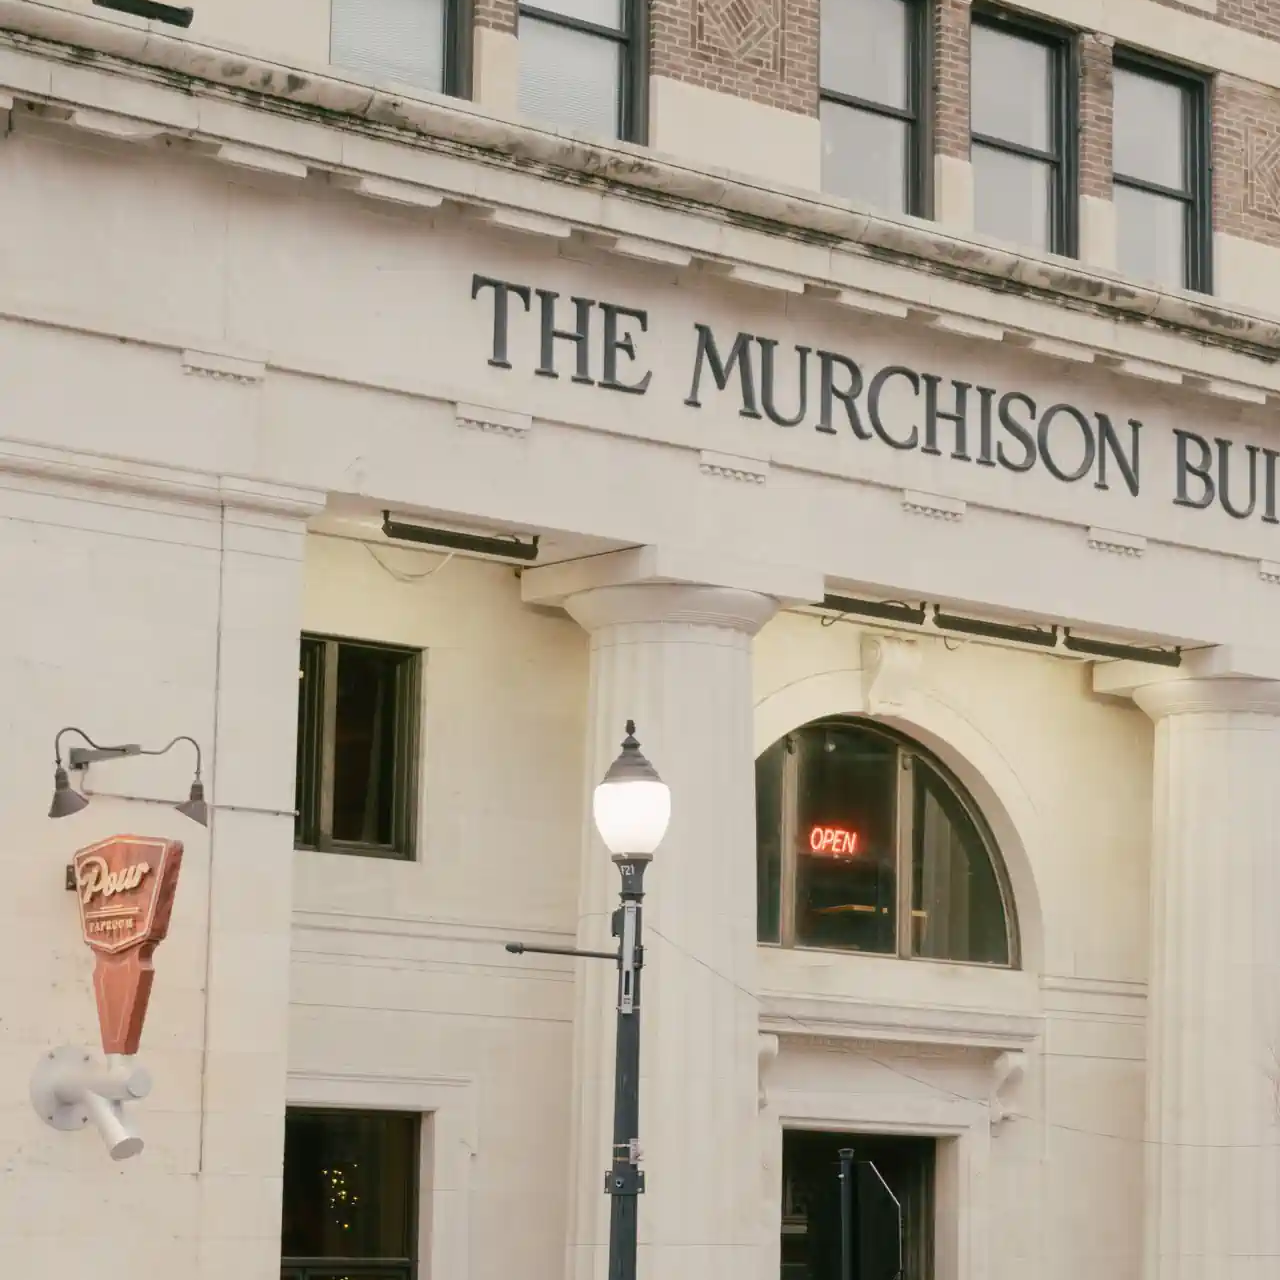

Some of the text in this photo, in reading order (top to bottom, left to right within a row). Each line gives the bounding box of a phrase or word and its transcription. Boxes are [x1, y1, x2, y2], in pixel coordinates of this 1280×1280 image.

[471, 272, 652, 395] THE
[683, 322, 1143, 498] MURCHISON
[810, 827, 858, 854] OPEN
[78, 855, 151, 905] Pour
